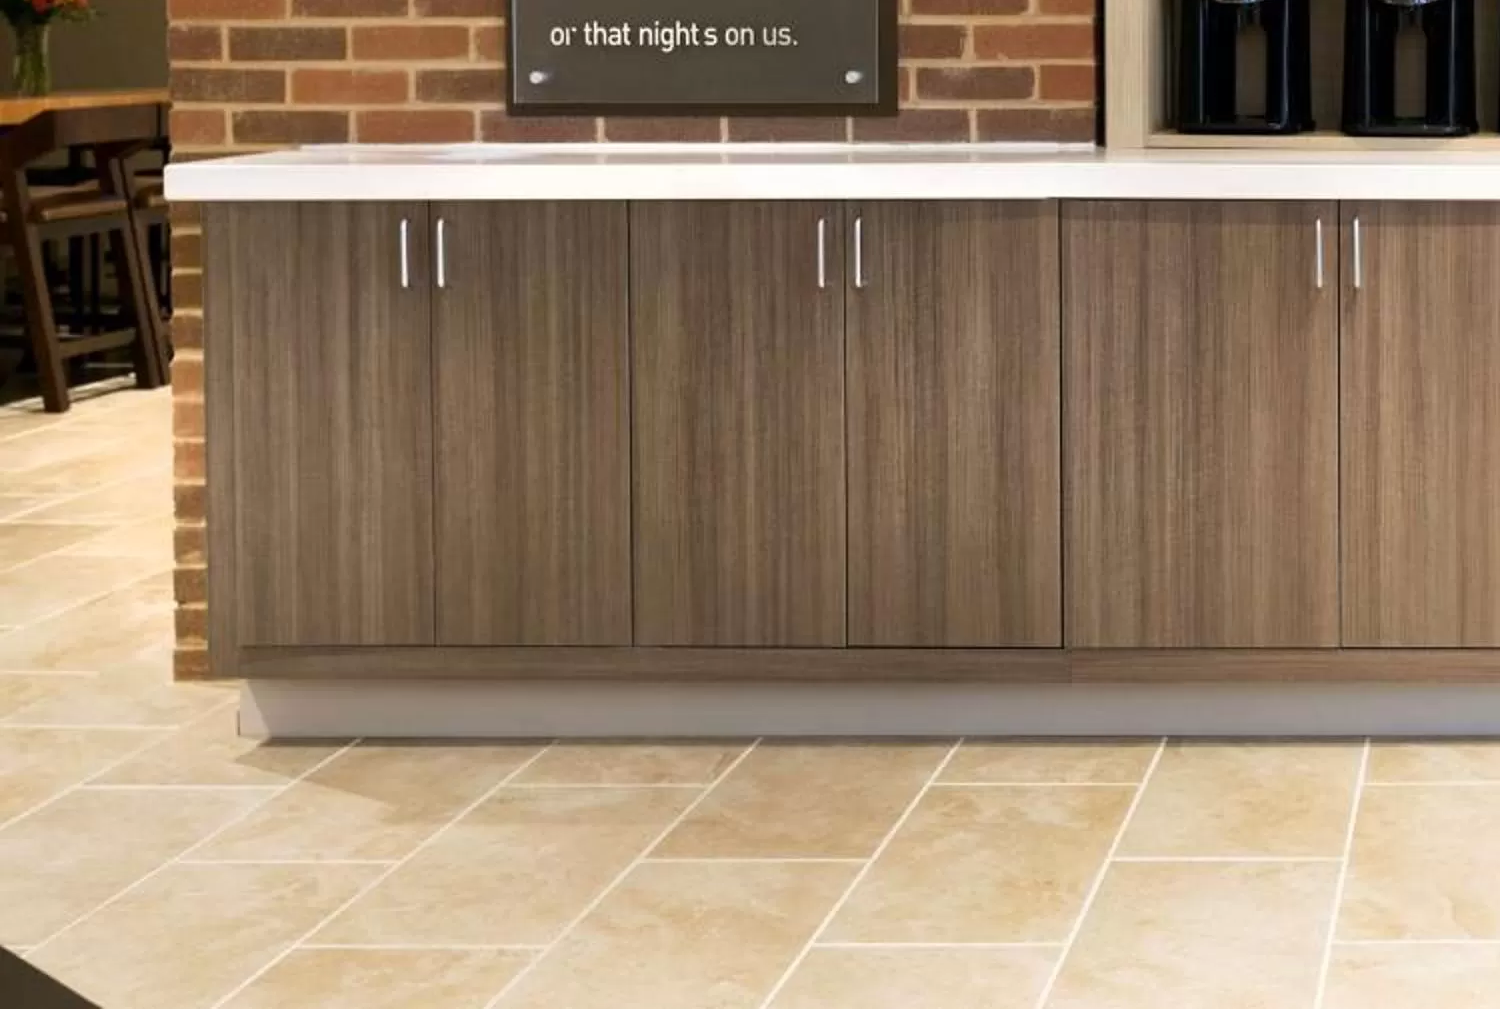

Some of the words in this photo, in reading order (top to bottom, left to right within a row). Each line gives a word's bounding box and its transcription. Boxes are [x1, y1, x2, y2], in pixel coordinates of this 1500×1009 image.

[549, 26, 577, 46] or
[583, 20, 631, 46] that
[725, 26, 755, 46] on
[763, 26, 799, 46] us.
